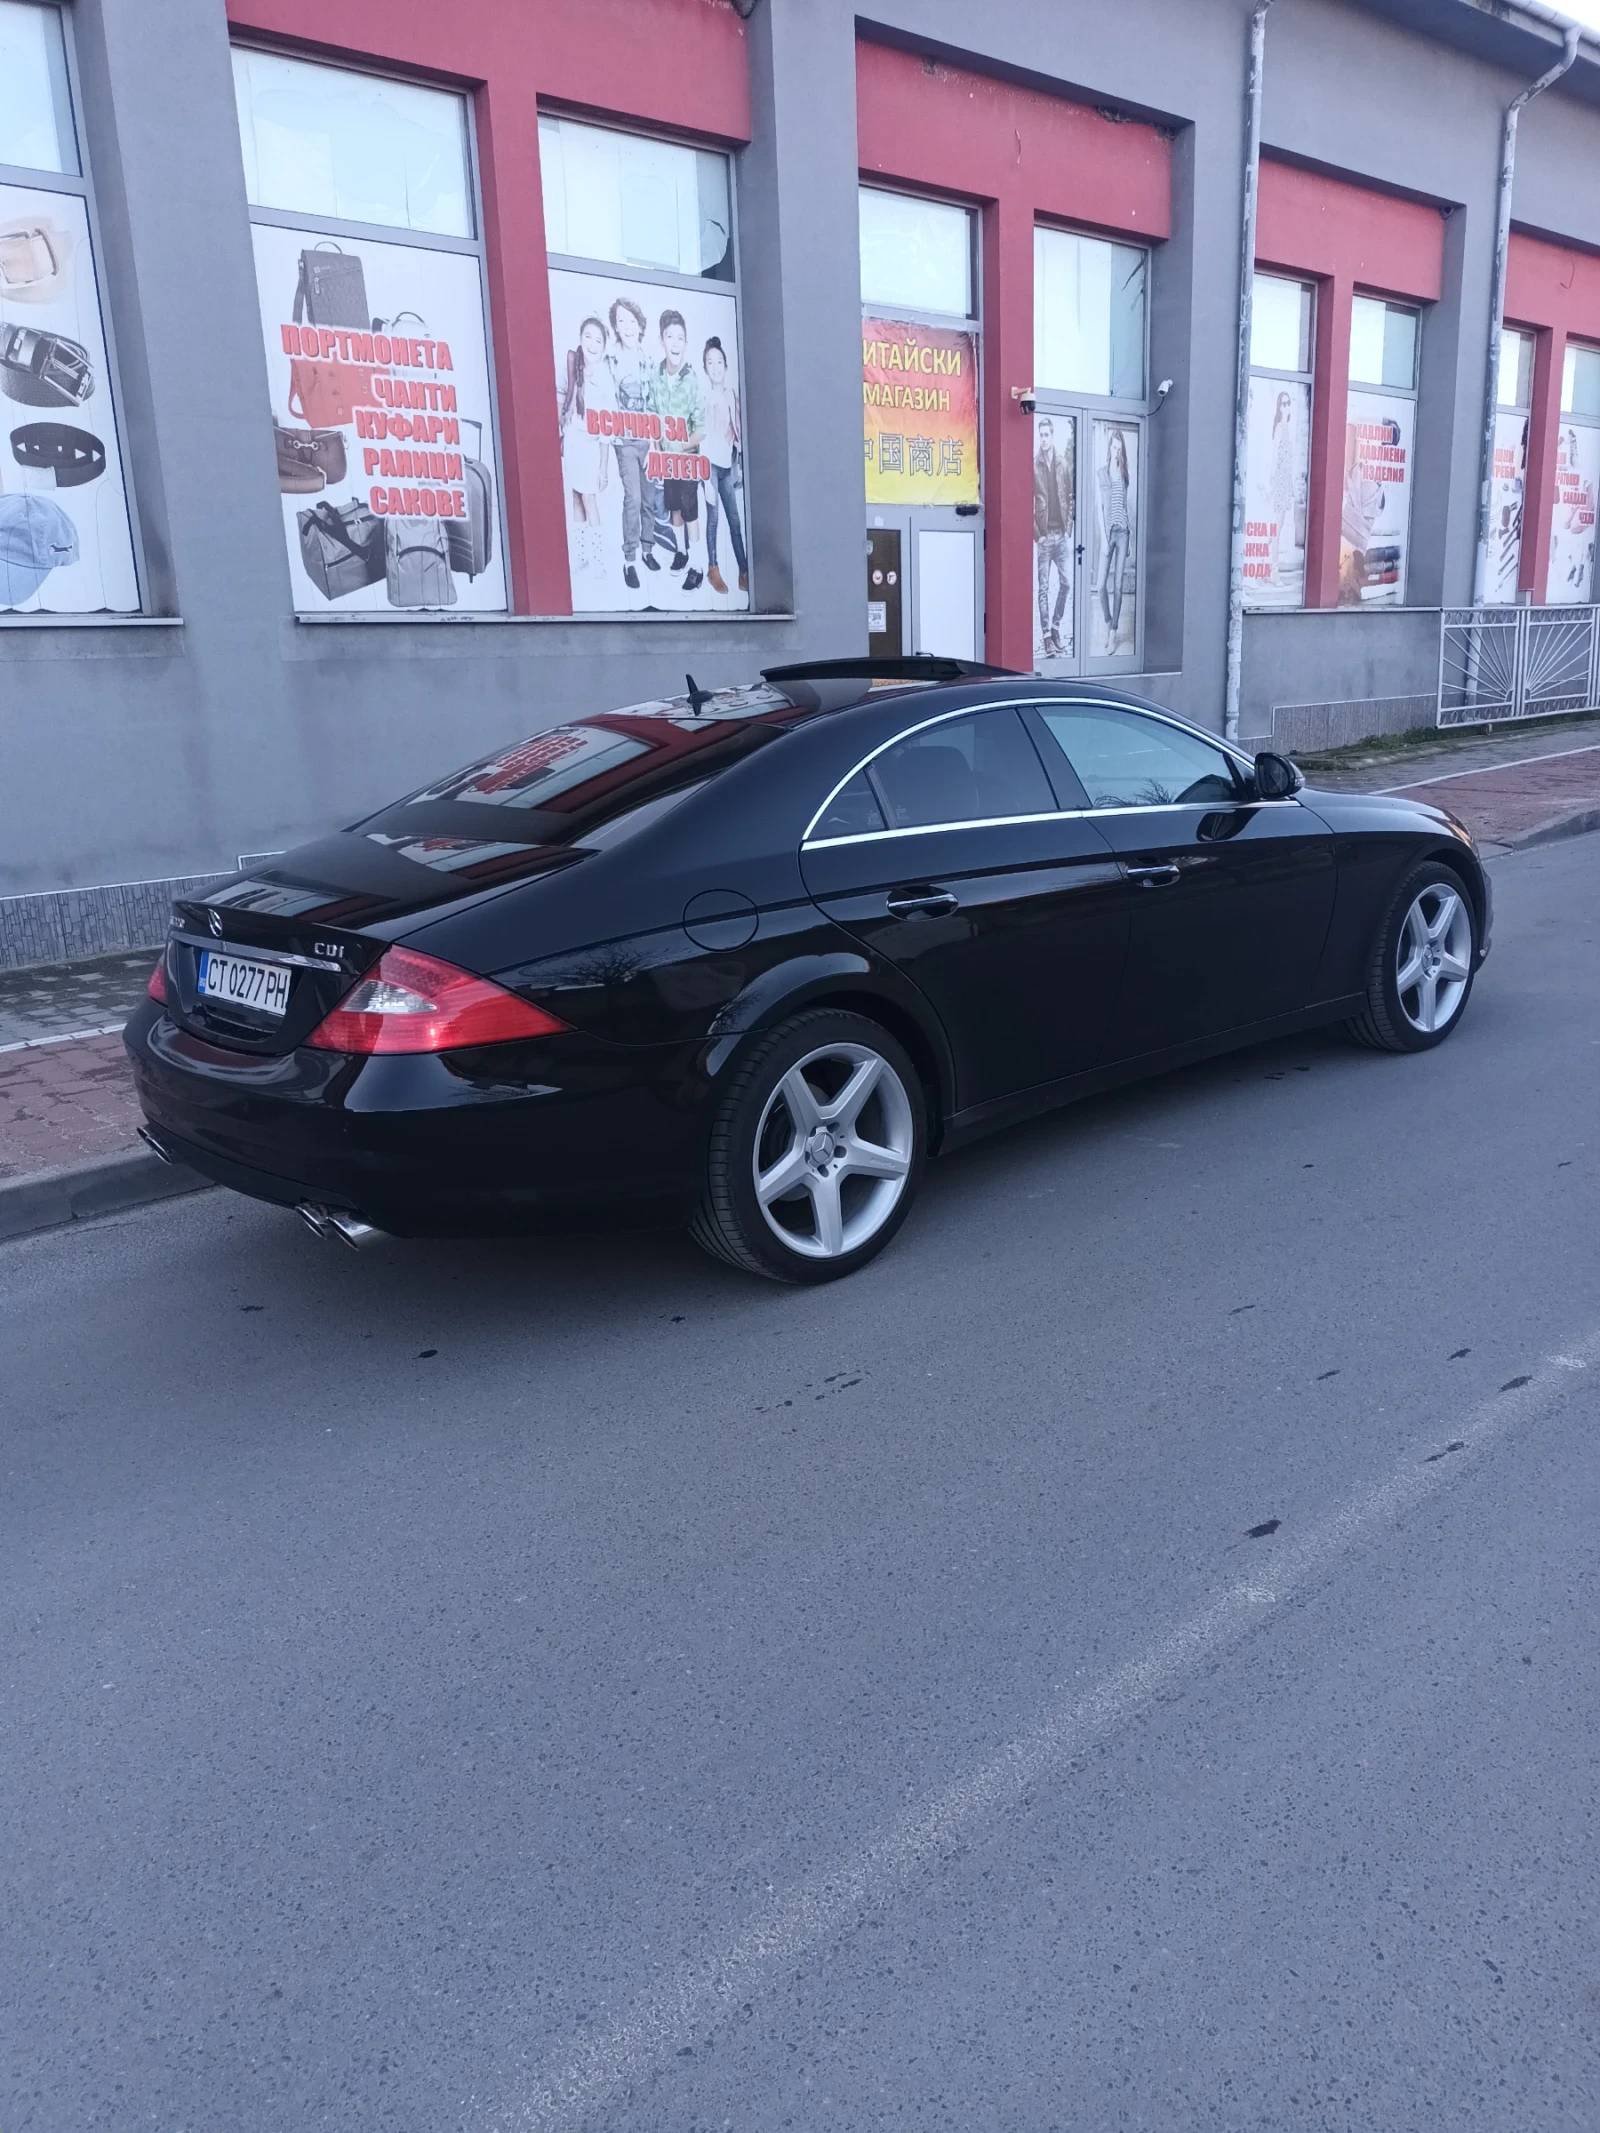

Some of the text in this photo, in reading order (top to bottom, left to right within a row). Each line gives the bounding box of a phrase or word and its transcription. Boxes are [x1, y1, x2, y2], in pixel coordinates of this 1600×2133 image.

[281, 324, 454, 371] ПОРТМОНЕТА
[863, 338, 961, 377] ИТАЙСКИ
[374, 378, 458, 412] ЧАНТИ
[863, 381, 950, 412] МАГАЗИН
[356, 410, 460, 445] КУФАРИ
[586, 408, 689, 442] ВСИЧКО ЗА
[1356, 423, 1393, 442] ХАВЛИИ
[363, 447, 463, 484] РАНИЦИ
[647, 452, 711, 481] ДЕТЕТО
[1359, 444, 1406, 463] ХАВЛИЕНИ
[1362, 465, 1405, 483] ИЗДЕЛИЯ
[370, 486, 467, 518] САКОВЕ
[1244, 521, 1277, 537] СКА И
[1244, 542, 1270, 557] ЖКА
